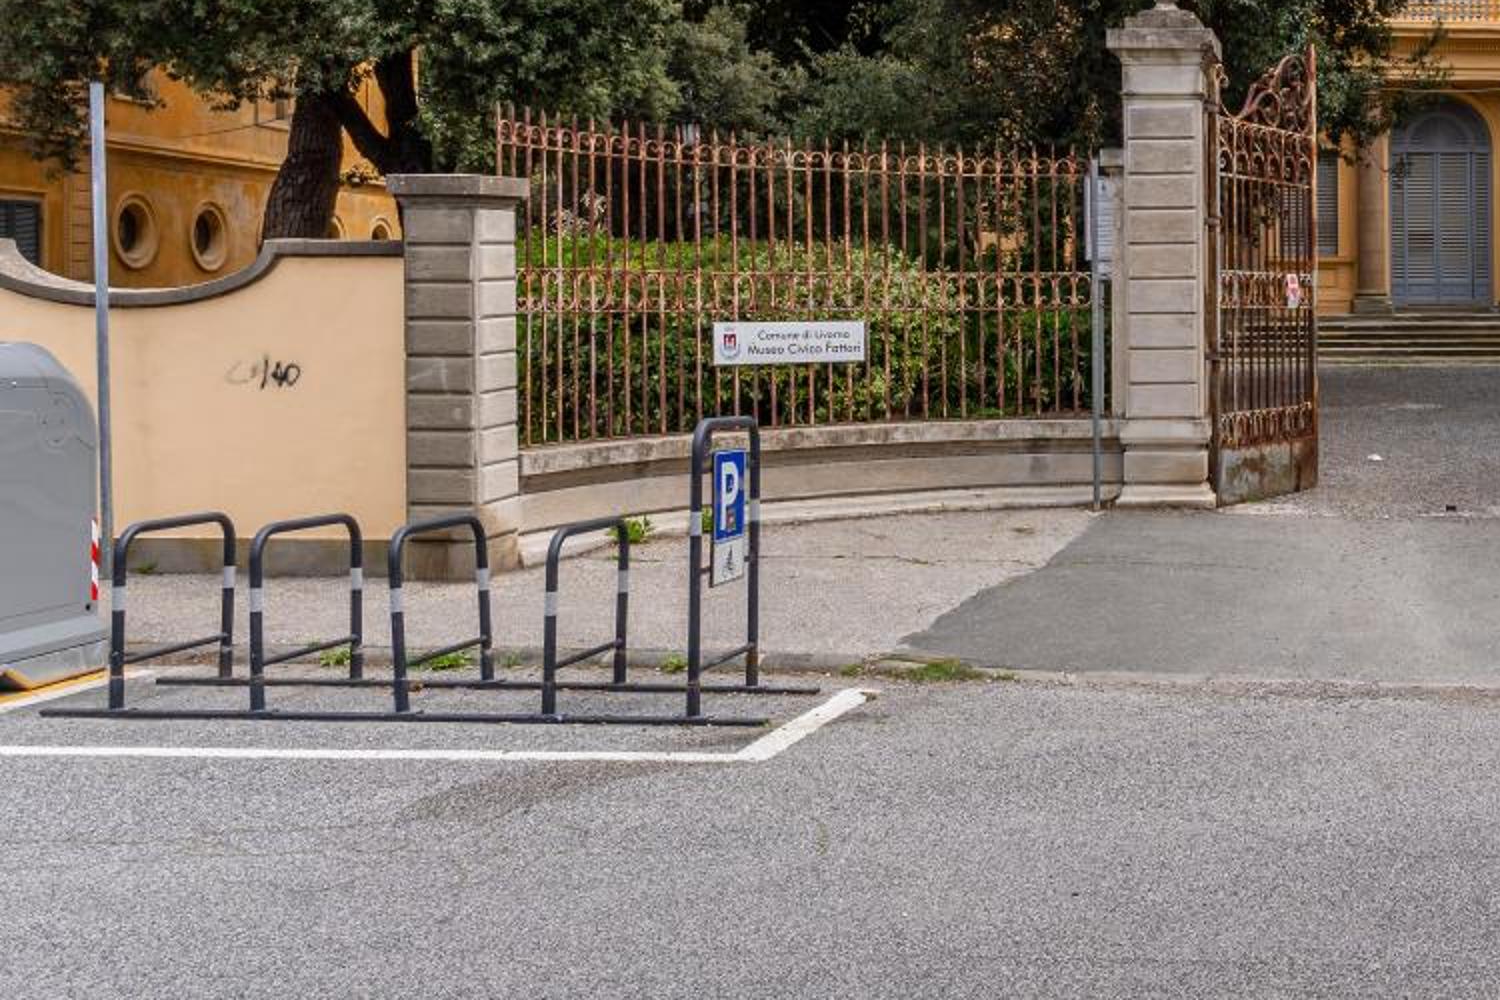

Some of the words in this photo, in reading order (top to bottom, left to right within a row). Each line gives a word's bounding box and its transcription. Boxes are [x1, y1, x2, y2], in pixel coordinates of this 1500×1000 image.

[757, 329, 798, 341] Comune
[802, 329, 812, 339] di
[815, 329, 850, 339] Livorno
[748, 343, 785, 356] Museo
[787, 343, 822, 355] Civico
[825, 341, 861, 353] Fattori
[720, 461, 739, 531] P
